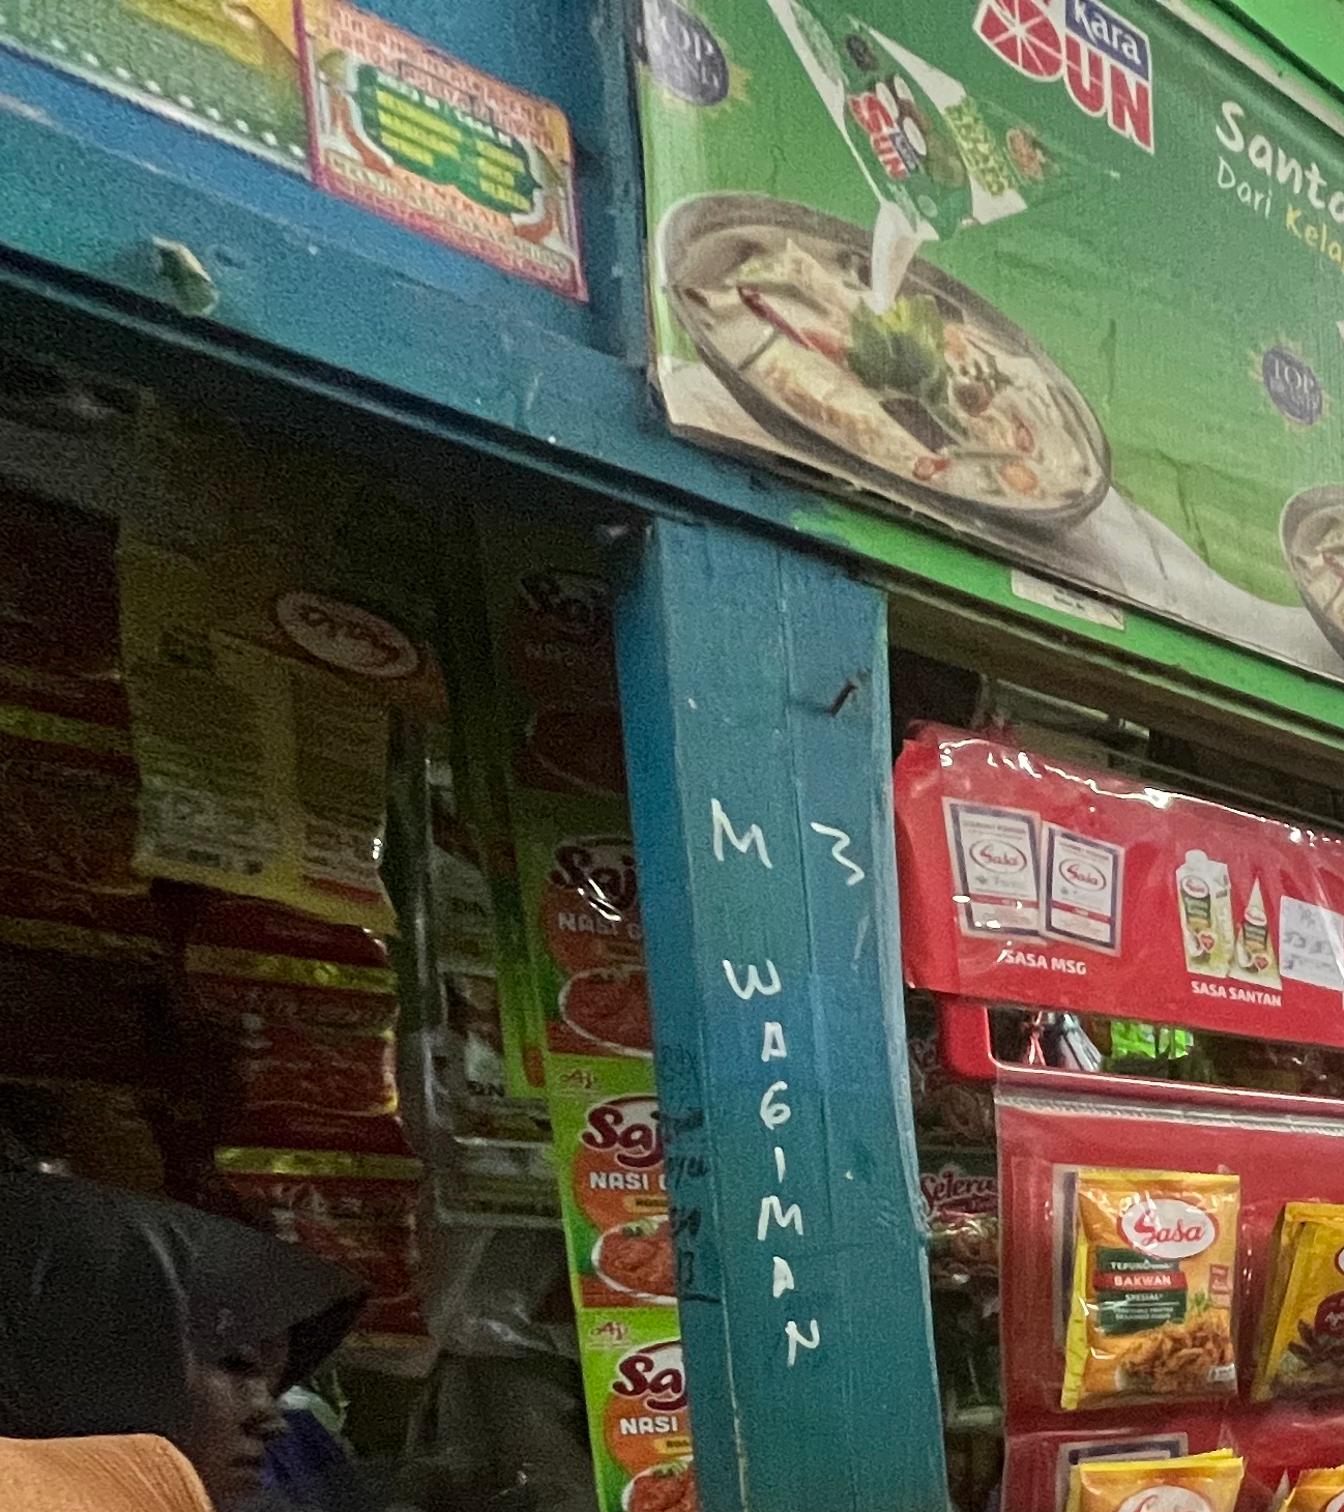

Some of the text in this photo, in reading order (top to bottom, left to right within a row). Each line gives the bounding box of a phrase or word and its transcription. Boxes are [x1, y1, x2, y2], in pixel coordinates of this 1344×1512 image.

[1217, 157, 1273, 217] Dari
[710, 798, 864, 887] M 3
[1004, 951, 1087, 975] SASA MSG
[1191, 980, 1282, 1007] SASA SANTAN
[590, 1171, 647, 1191] NASI
[1134, 1211, 1204, 1247] Sasa
[1114, 1275, 1172, 1287] BAKWAN
[620, 1416, 678, 1435] NASI
